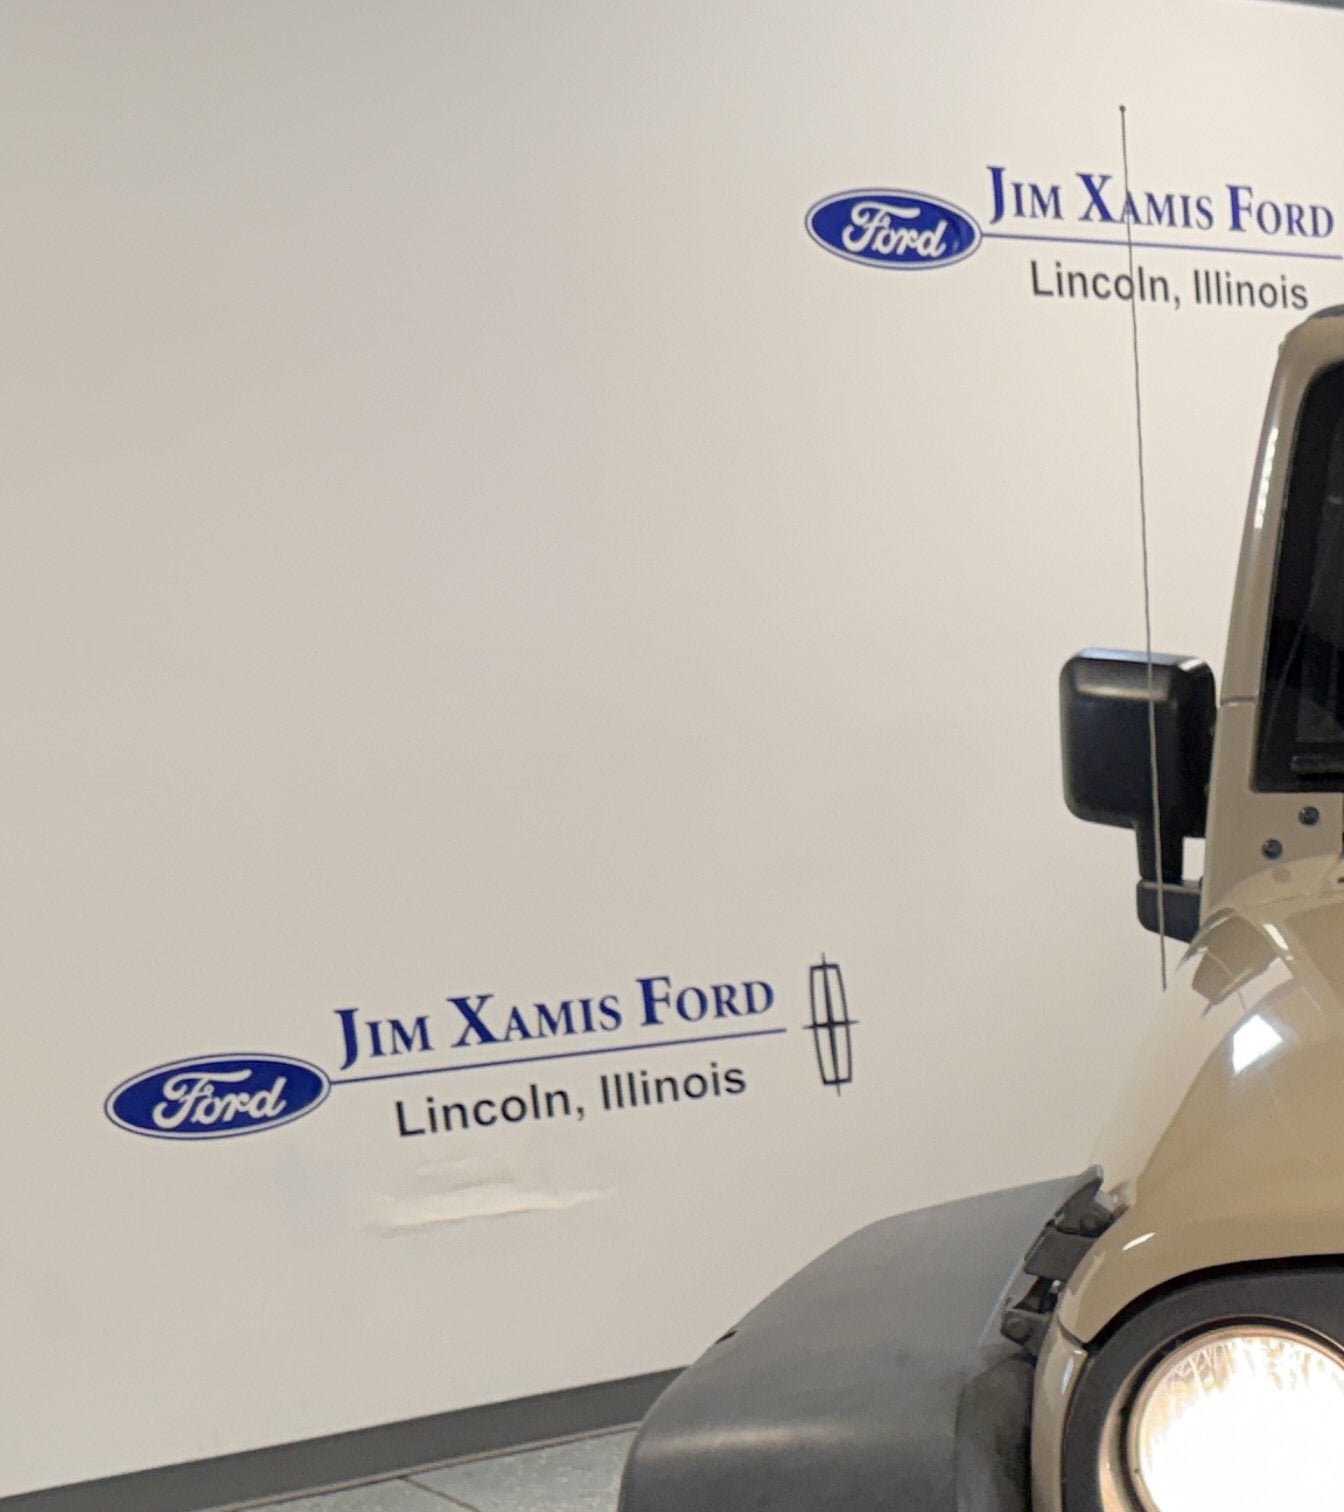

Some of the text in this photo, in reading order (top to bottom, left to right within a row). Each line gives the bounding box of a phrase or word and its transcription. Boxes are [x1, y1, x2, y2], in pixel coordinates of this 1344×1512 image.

[842, 200, 947, 258] Ford
[986, 165, 1335, 239] JIM XAMIS FORD
[1030, 260, 1309, 311] Lincoln, Illinois
[334, 976, 775, 1071] JIM XAMIS FORD
[152, 1069, 288, 1129] Ford
[395, 1061, 747, 1138] Lincoln, Illinois
